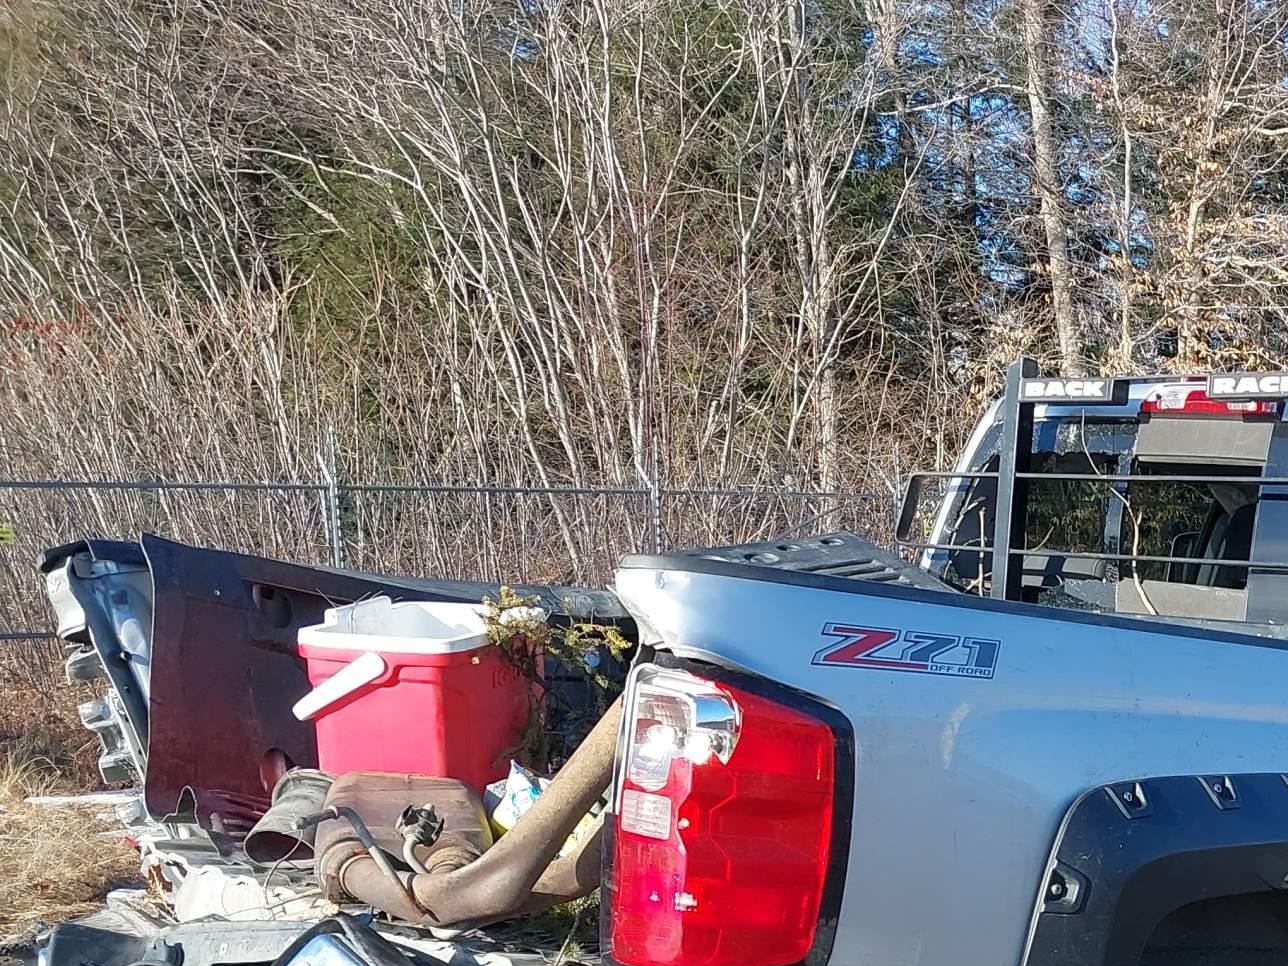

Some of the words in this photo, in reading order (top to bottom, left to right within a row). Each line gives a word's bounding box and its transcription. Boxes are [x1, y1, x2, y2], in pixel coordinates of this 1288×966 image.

[1023, 379, 1105, 398] BACK
[811, 621, 1001, 678] Z71
[929, 663, 954, 673] OFF
[957, 666, 992, 677] ROAD
